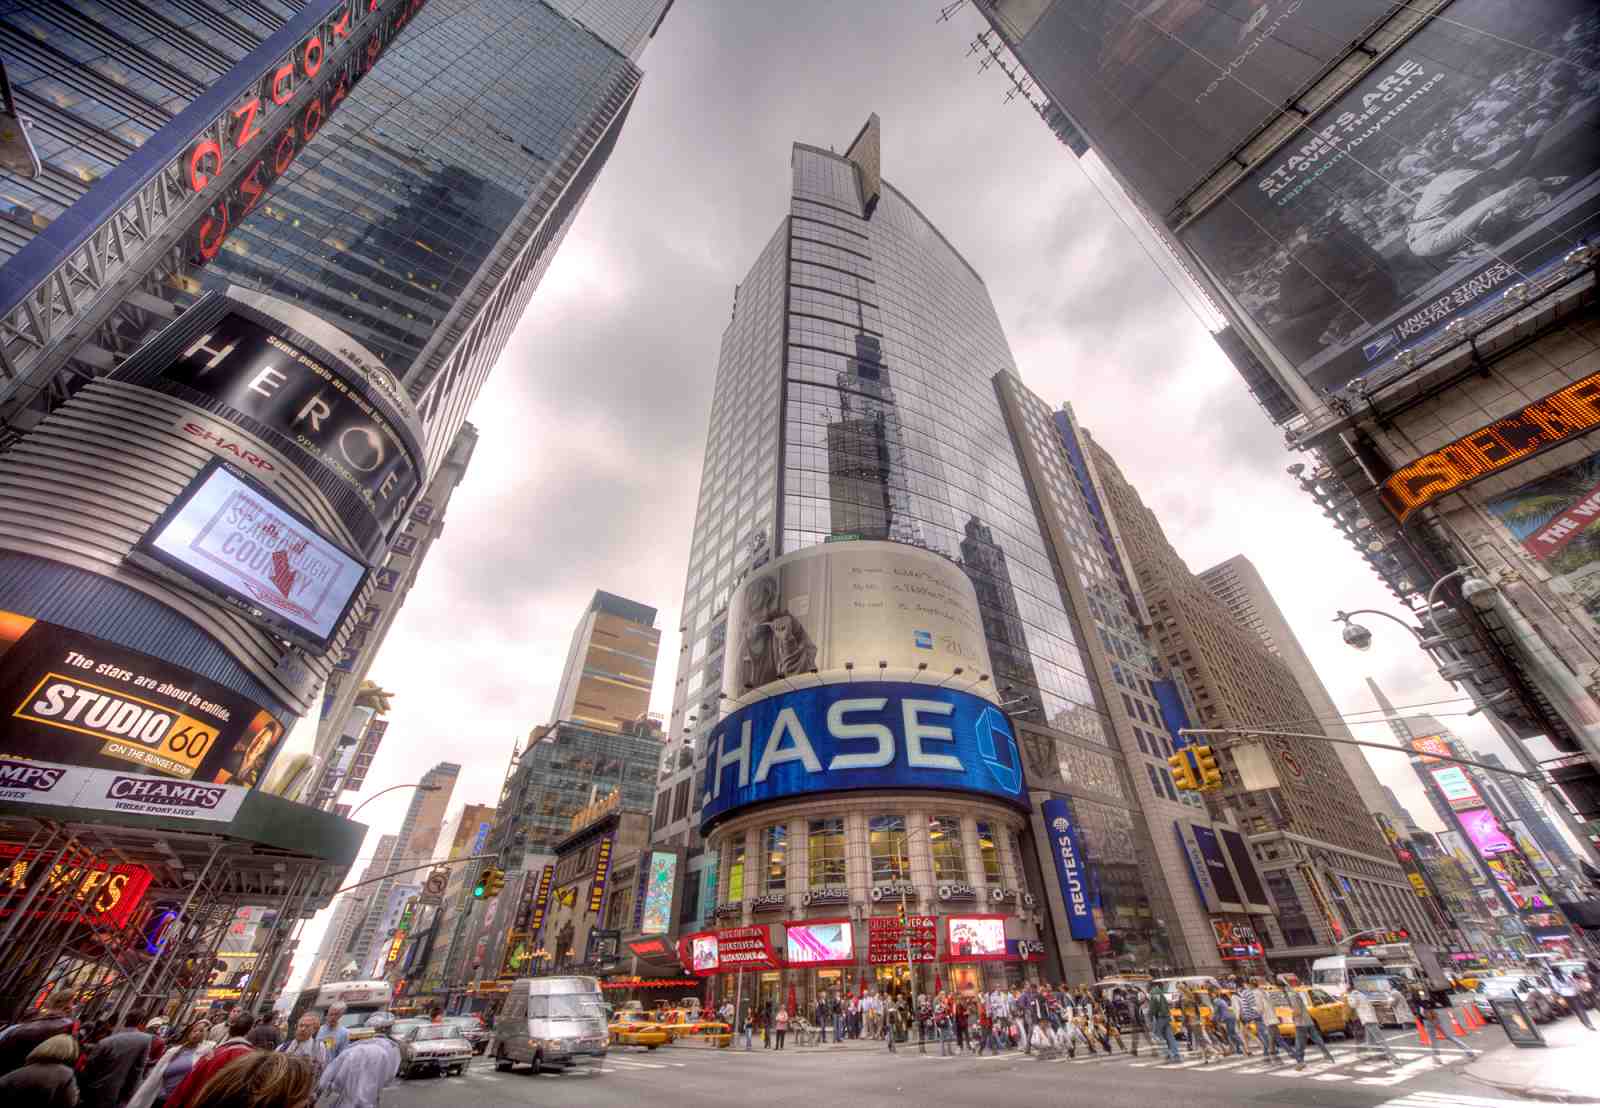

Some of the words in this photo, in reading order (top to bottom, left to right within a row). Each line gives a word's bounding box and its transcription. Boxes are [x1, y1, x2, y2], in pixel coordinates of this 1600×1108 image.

[1258, 111, 1356, 193] STAMPS
[1362, 59, 1420, 108] ARE
[1267, 174, 1297, 199] ALL
[1298, 135, 1345, 172] OVER
[1343, 104, 1382, 133] THE
[1382, 65, 1425, 103] CITY
[1277, 72, 1445, 207] usps.com/buystamps
[1397, 295, 1451, 332] UNITED
[1400, 306, 1457, 340] POSTAL
[1455, 266, 1516, 306] SERVICE
[266, 335, 299, 359] Some
[298, 354, 333, 382] people
[182, 422, 275, 471] SHARP
[1537, 517, 1580, 544] THE
[222, 530, 314, 597] COUNY
[64, 651, 95, 670] The
[96, 662, 134, 682] stars
[133, 674, 156, 690] are
[156, 681, 191, 703] about
[189, 693, 202, 708] to
[33, 683, 172, 744] STUDIO
[168, 725, 210, 759] 60
[108, 742, 126, 755] ON
[127, 747, 146, 760] THE
[111, 779, 220, 808] CHAMPS
[115, 801, 145, 811] WHERE
[147, 805, 172, 815] SPORT
[171, 807, 196, 817] LIVES
[1058, 835, 1088, 916] REUTERS
